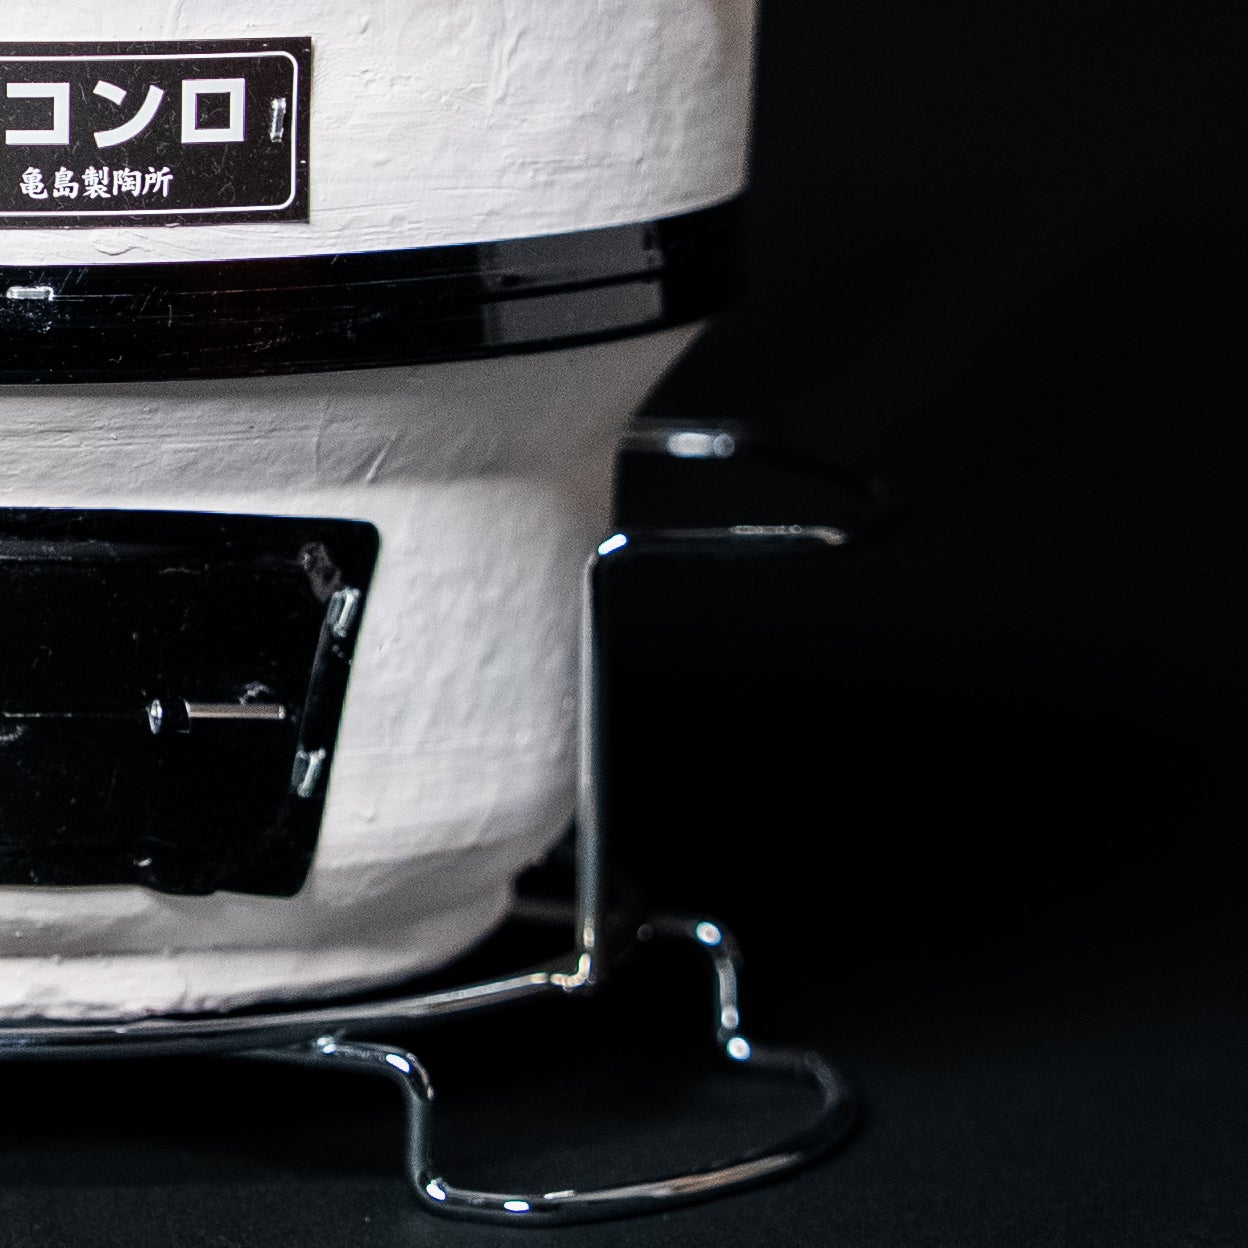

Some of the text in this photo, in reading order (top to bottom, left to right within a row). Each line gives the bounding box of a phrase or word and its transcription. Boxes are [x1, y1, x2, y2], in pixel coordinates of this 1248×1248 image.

[19, 166, 174, 199] 亀島製陶所
